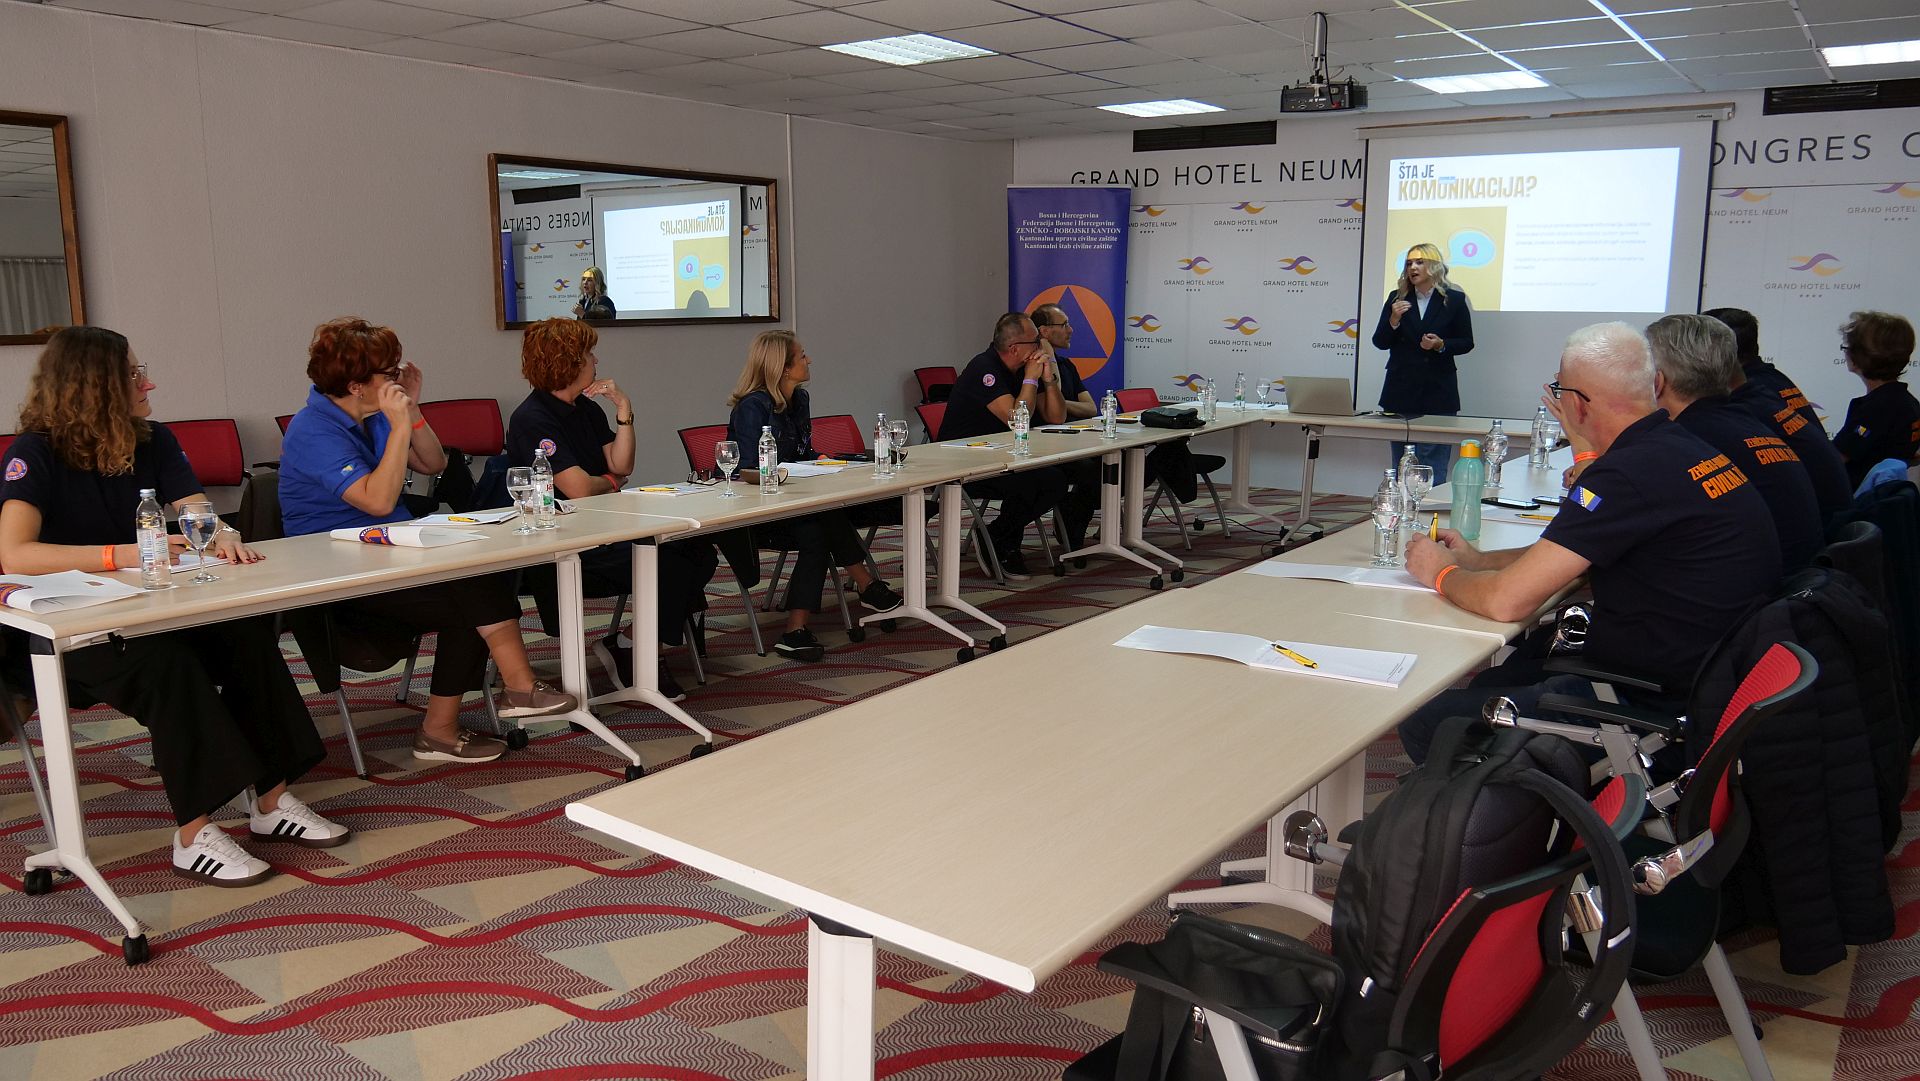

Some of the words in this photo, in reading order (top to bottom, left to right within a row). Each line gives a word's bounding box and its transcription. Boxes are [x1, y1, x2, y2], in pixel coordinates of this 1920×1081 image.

[1713, 134, 1872, 168] ONGRES
[1070, 167, 1160, 188] GRAND
[1174, 162, 1263, 186] HOTEL
[1279, 158, 1363, 183] NEUM
[1399, 161, 1419, 180] ŠTA
[1421, 164, 1435, 178] JE
[1398, 175, 1538, 202] KOMUNIKACIJA?
[1062, 211, 1099, 220] Hercegovina
[1761, 208, 1788, 216] NEUM
[1847, 206, 1882, 214] GRAND
[1885, 205, 1918, 213] HOTEL
[1022, 219, 1054, 227] Federacija
[1078, 219, 1115, 227] Hercegovine
